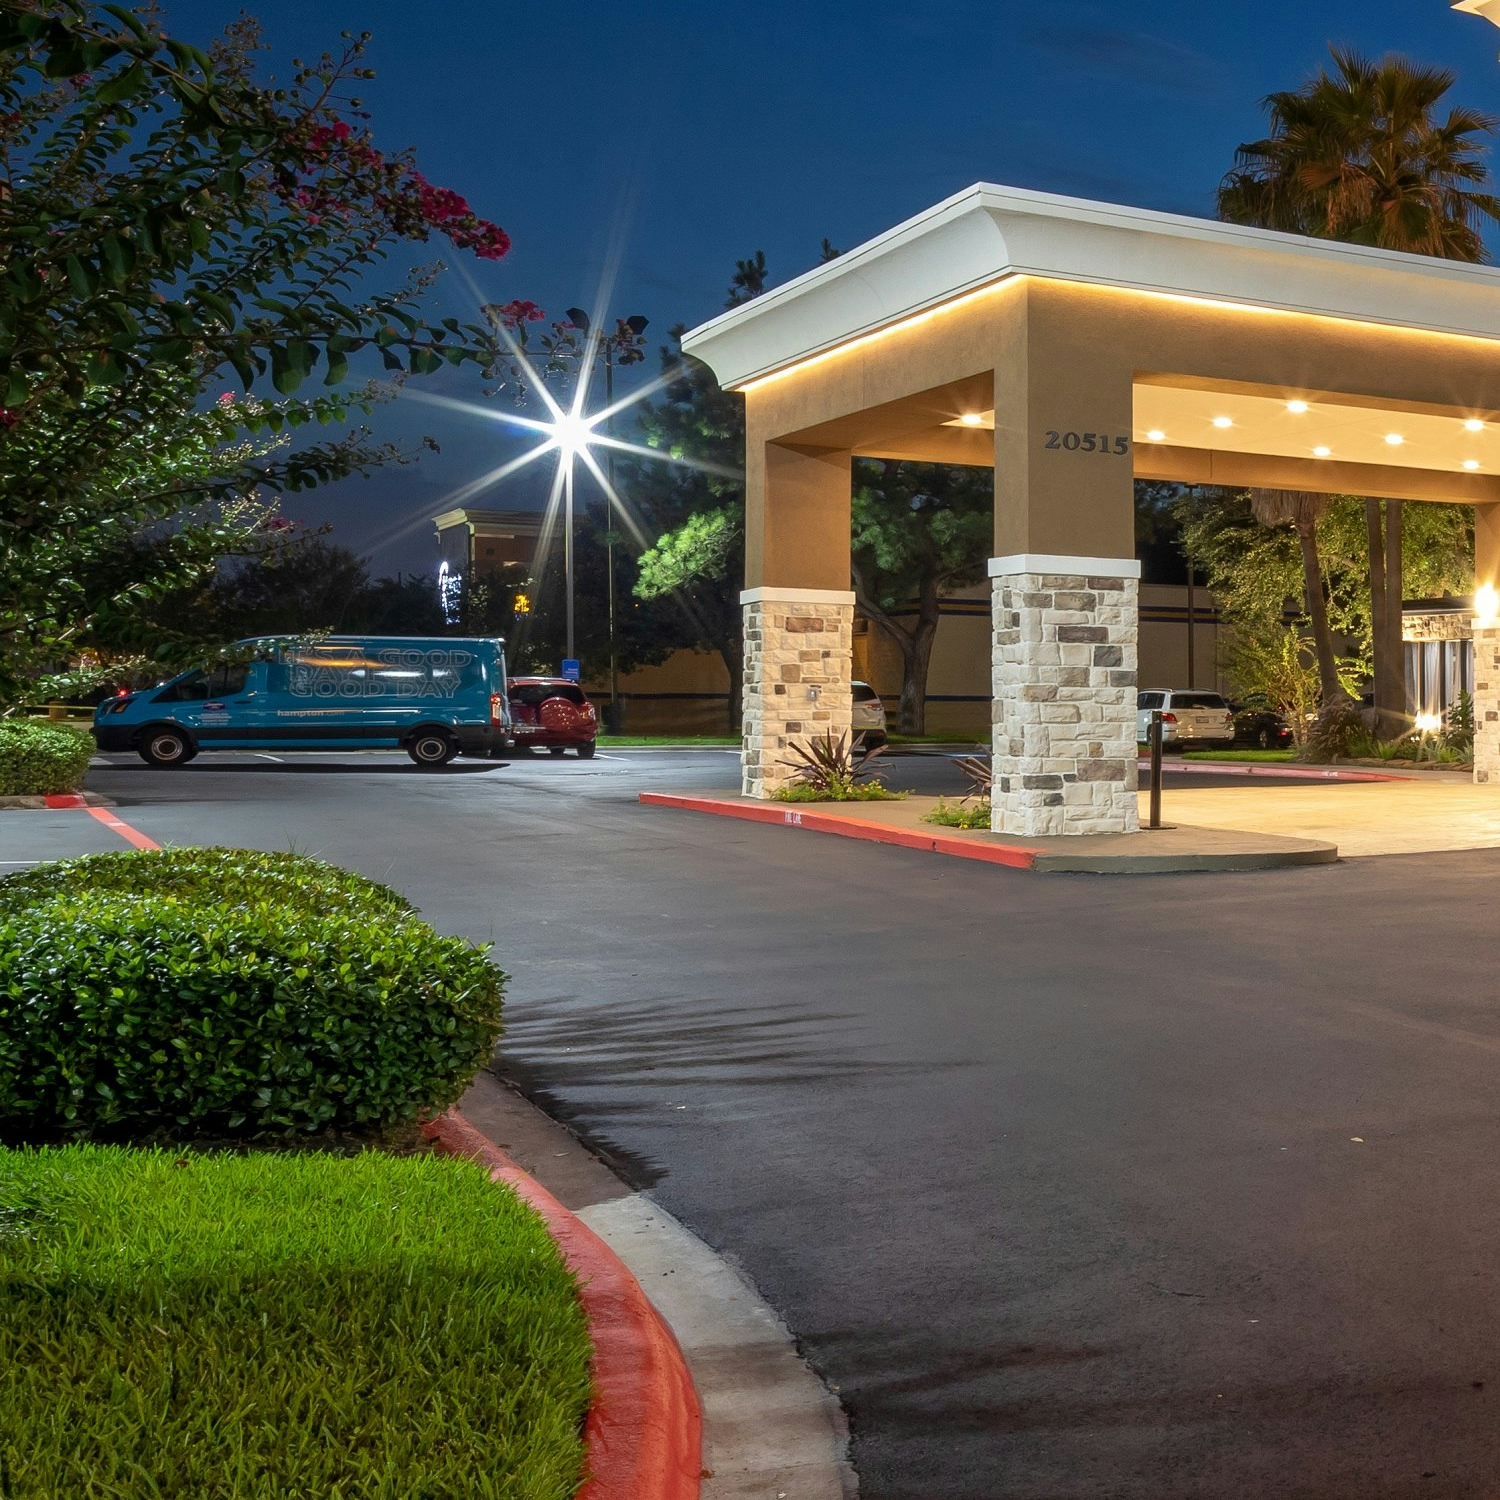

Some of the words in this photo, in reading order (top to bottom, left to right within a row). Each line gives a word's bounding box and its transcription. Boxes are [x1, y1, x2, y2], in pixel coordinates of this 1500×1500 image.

[1044, 430, 1129, 456] 20515
[377, 648, 472, 668] GOOD
[288, 680, 385, 699] GOOD
[396, 680, 461, 699] DAY
